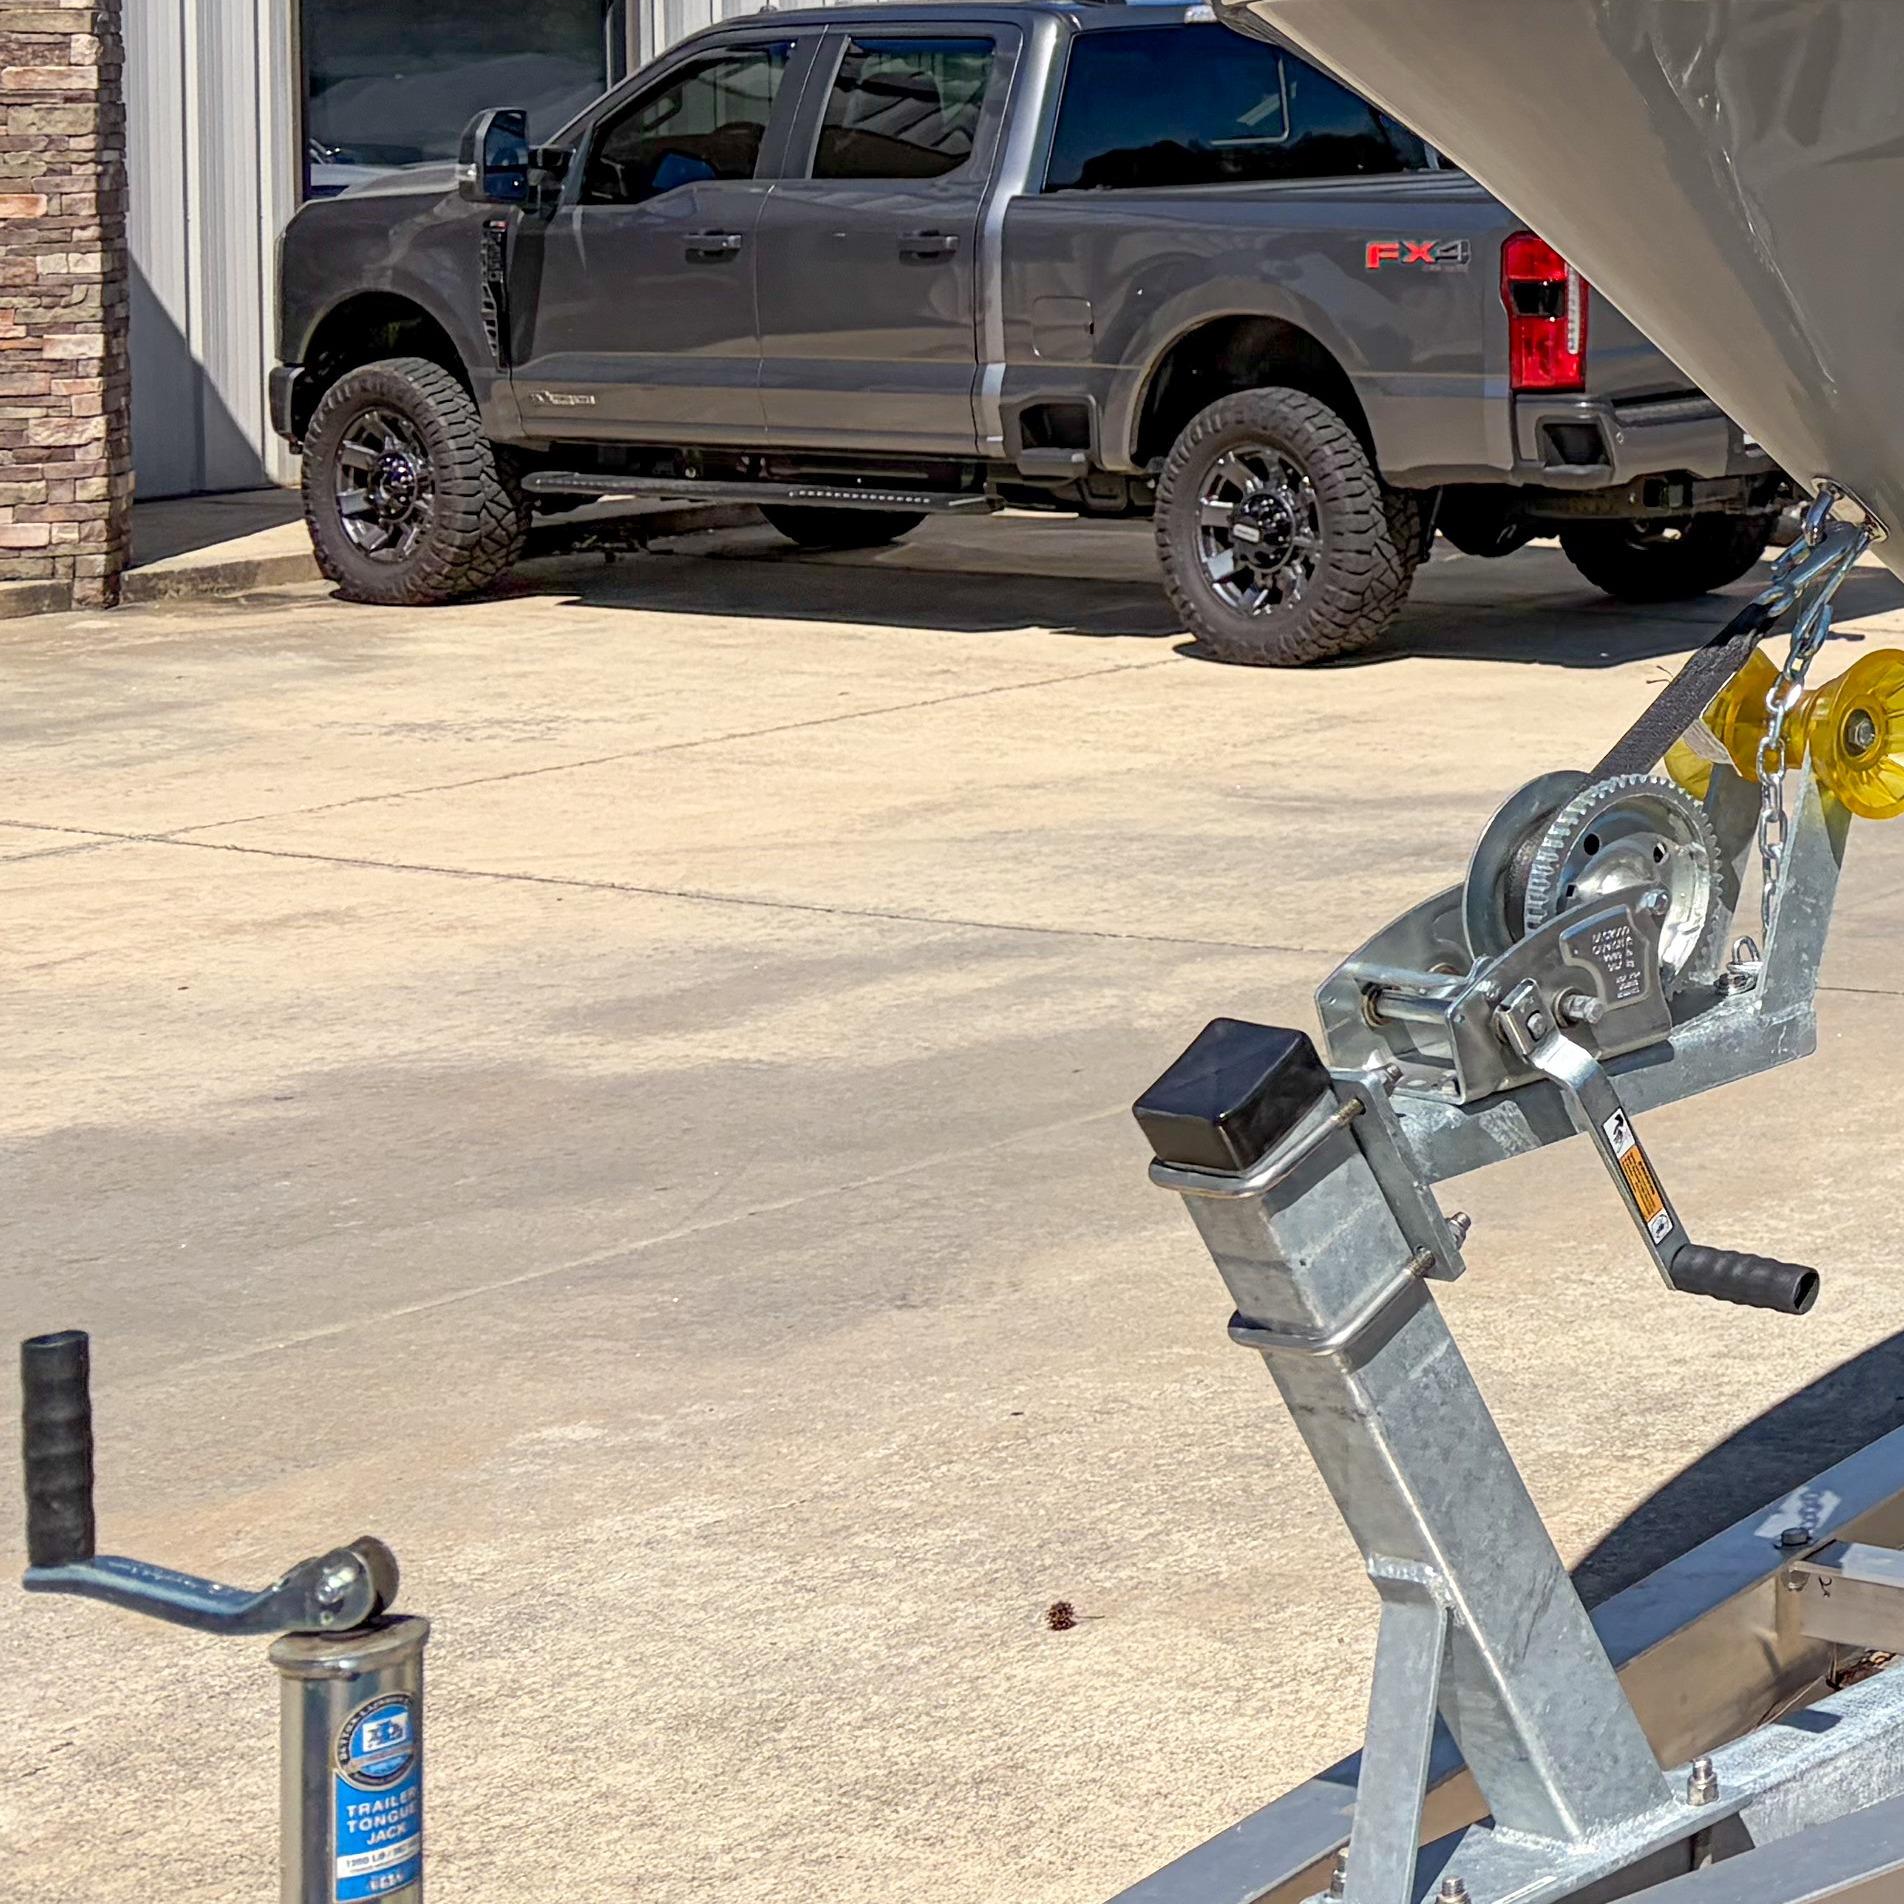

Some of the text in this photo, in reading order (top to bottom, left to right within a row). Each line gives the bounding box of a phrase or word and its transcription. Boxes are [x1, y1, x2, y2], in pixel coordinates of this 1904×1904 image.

[1365, 239, 1471, 270] FX4
[346, 1786, 418, 1818] TRAILER
[346, 1801, 417, 1834] TONGUE
[366, 1822, 408, 1846] JACK
